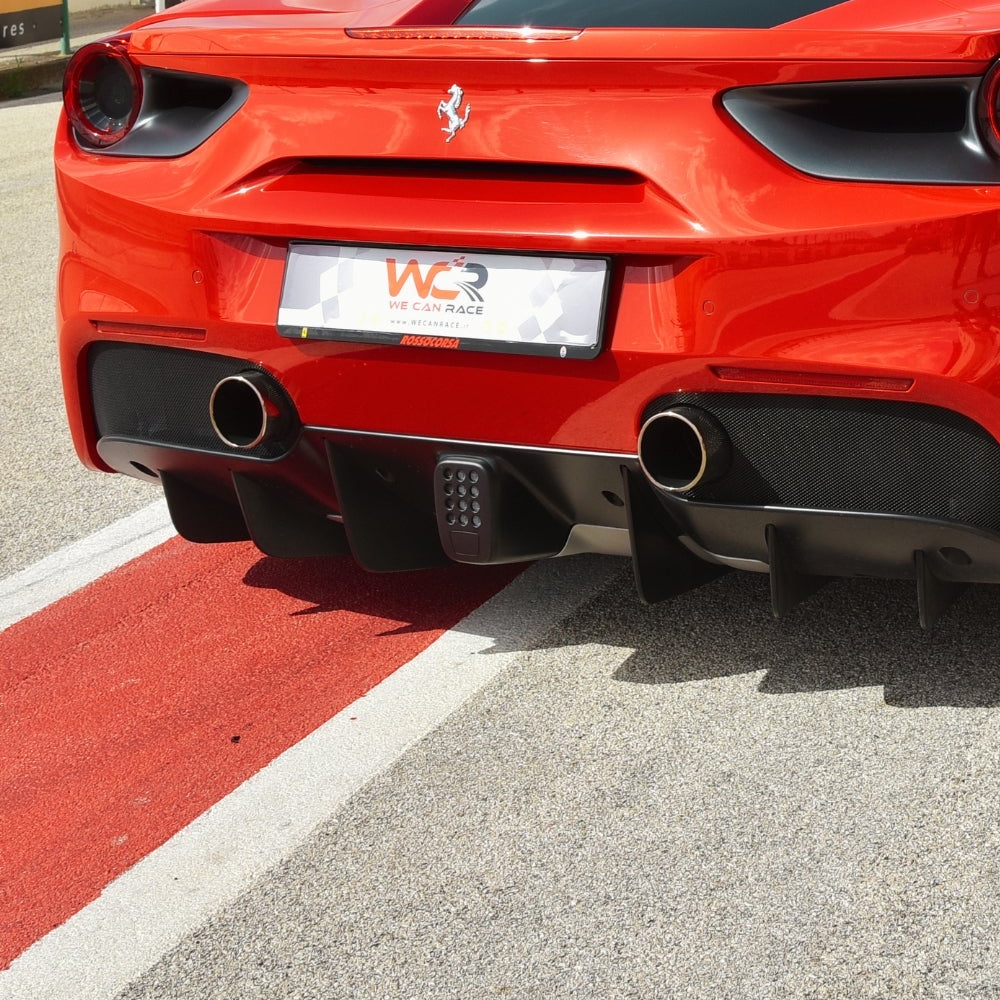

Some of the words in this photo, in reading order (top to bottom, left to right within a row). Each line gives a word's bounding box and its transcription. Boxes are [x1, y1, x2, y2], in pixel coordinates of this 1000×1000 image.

[389, 300, 409, 310] WE
[412, 302, 442, 312] CAN
[445, 304, 485, 315] RACE
[400, 334, 460, 349] ROSSOCORSA
